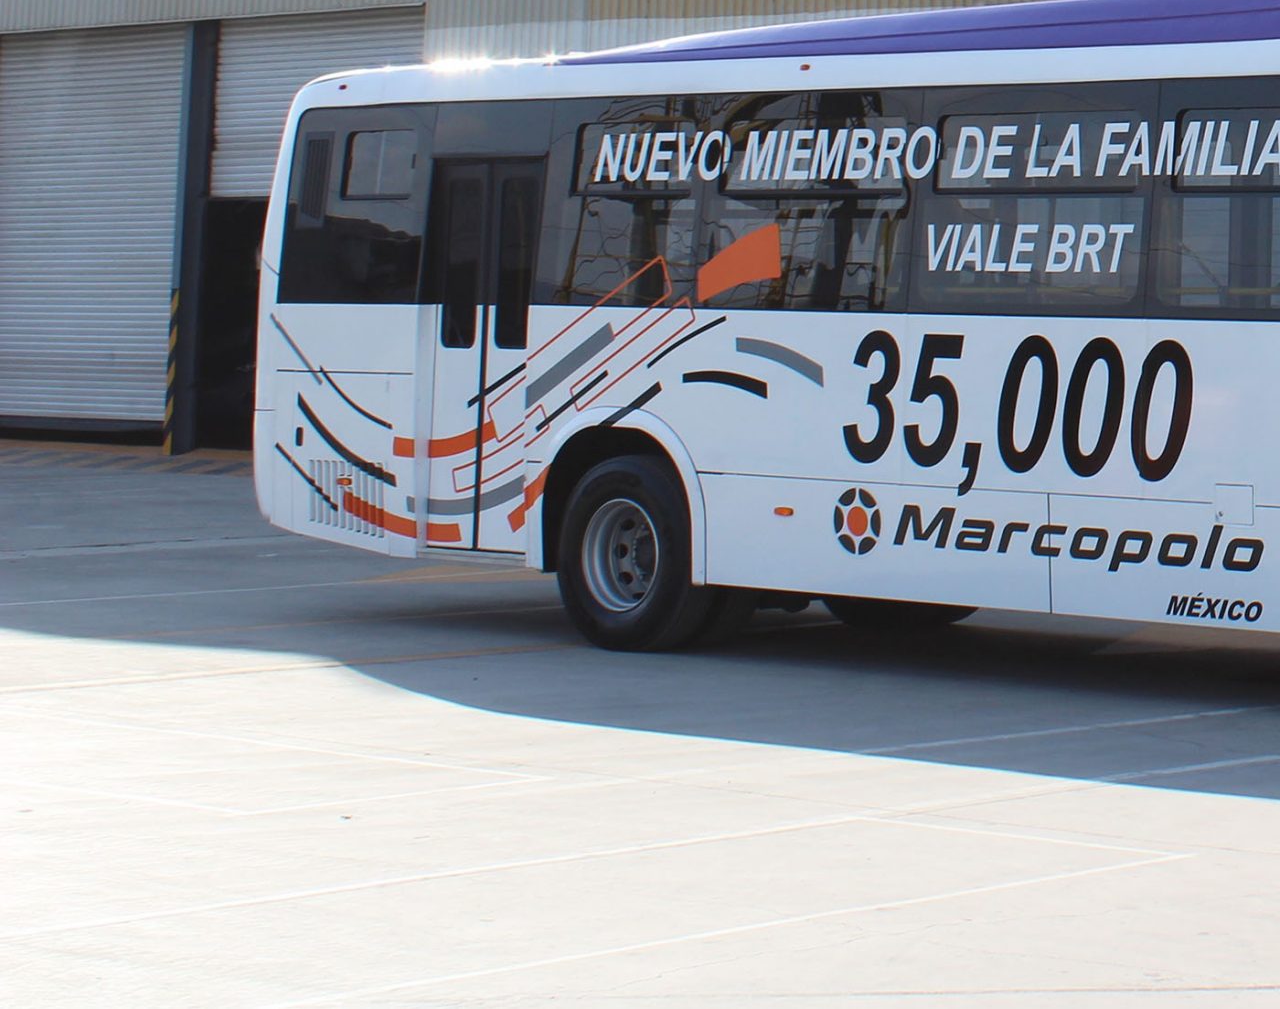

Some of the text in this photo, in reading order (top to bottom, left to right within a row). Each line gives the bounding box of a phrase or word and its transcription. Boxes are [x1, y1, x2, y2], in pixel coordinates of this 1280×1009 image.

[594, 130, 730, 181] NUEVO
[740, 126, 939, 181] MIEMBRO
[951, 125, 1018, 180] DE
[1025, 123, 1081, 178] LA
[927, 223, 1135, 273] VIALE BRT
[842, 330, 1194, 496] 35,000
[893, 504, 1265, 572] Marcopolo
[1166, 592, 1264, 622] MÉXICO
